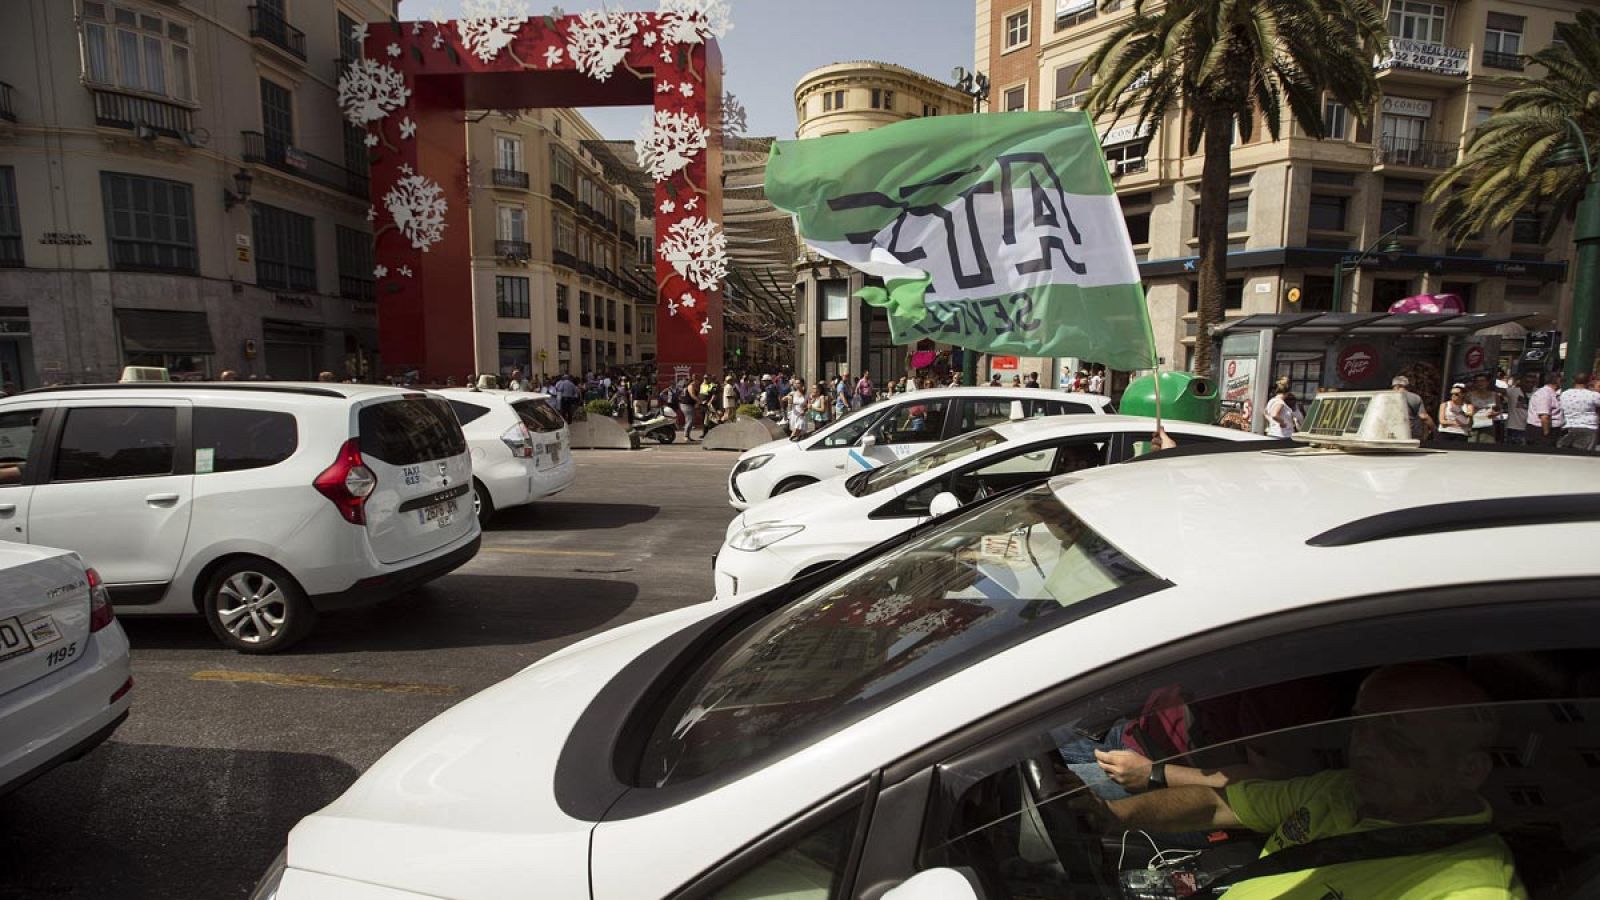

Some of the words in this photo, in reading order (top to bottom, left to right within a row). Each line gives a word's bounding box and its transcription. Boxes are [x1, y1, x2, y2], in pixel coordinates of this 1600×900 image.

[1412, 54, 1434, 65] 260
[1316, 399, 1353, 429] TAXI
[403, 465, 420, 477] TAXI
[47, 642, 77, 666] 1195
